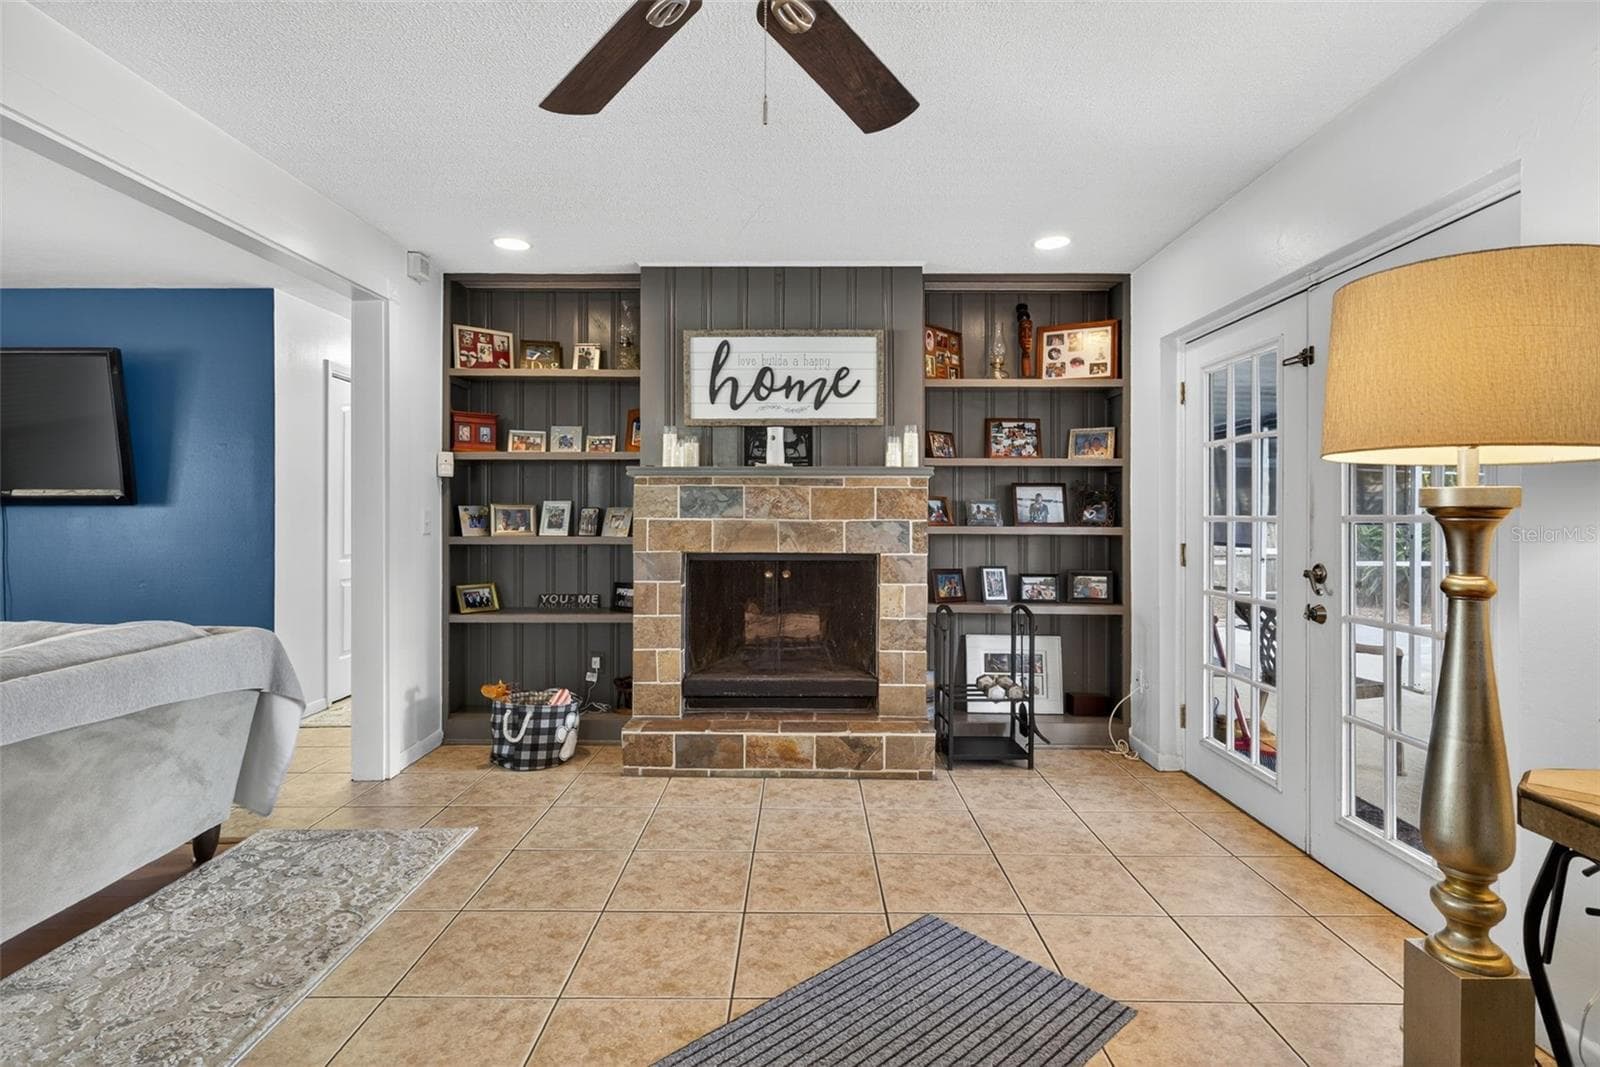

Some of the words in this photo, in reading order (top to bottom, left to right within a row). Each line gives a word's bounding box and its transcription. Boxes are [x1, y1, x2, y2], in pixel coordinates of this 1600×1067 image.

[737, 353, 757, 367] love
[792, 358, 799, 367] a
[803, 353, 831, 370] happy
[709, 339, 861, 411] home
[540, 594, 569, 604] YOU
[577, 594, 599, 604] ME
